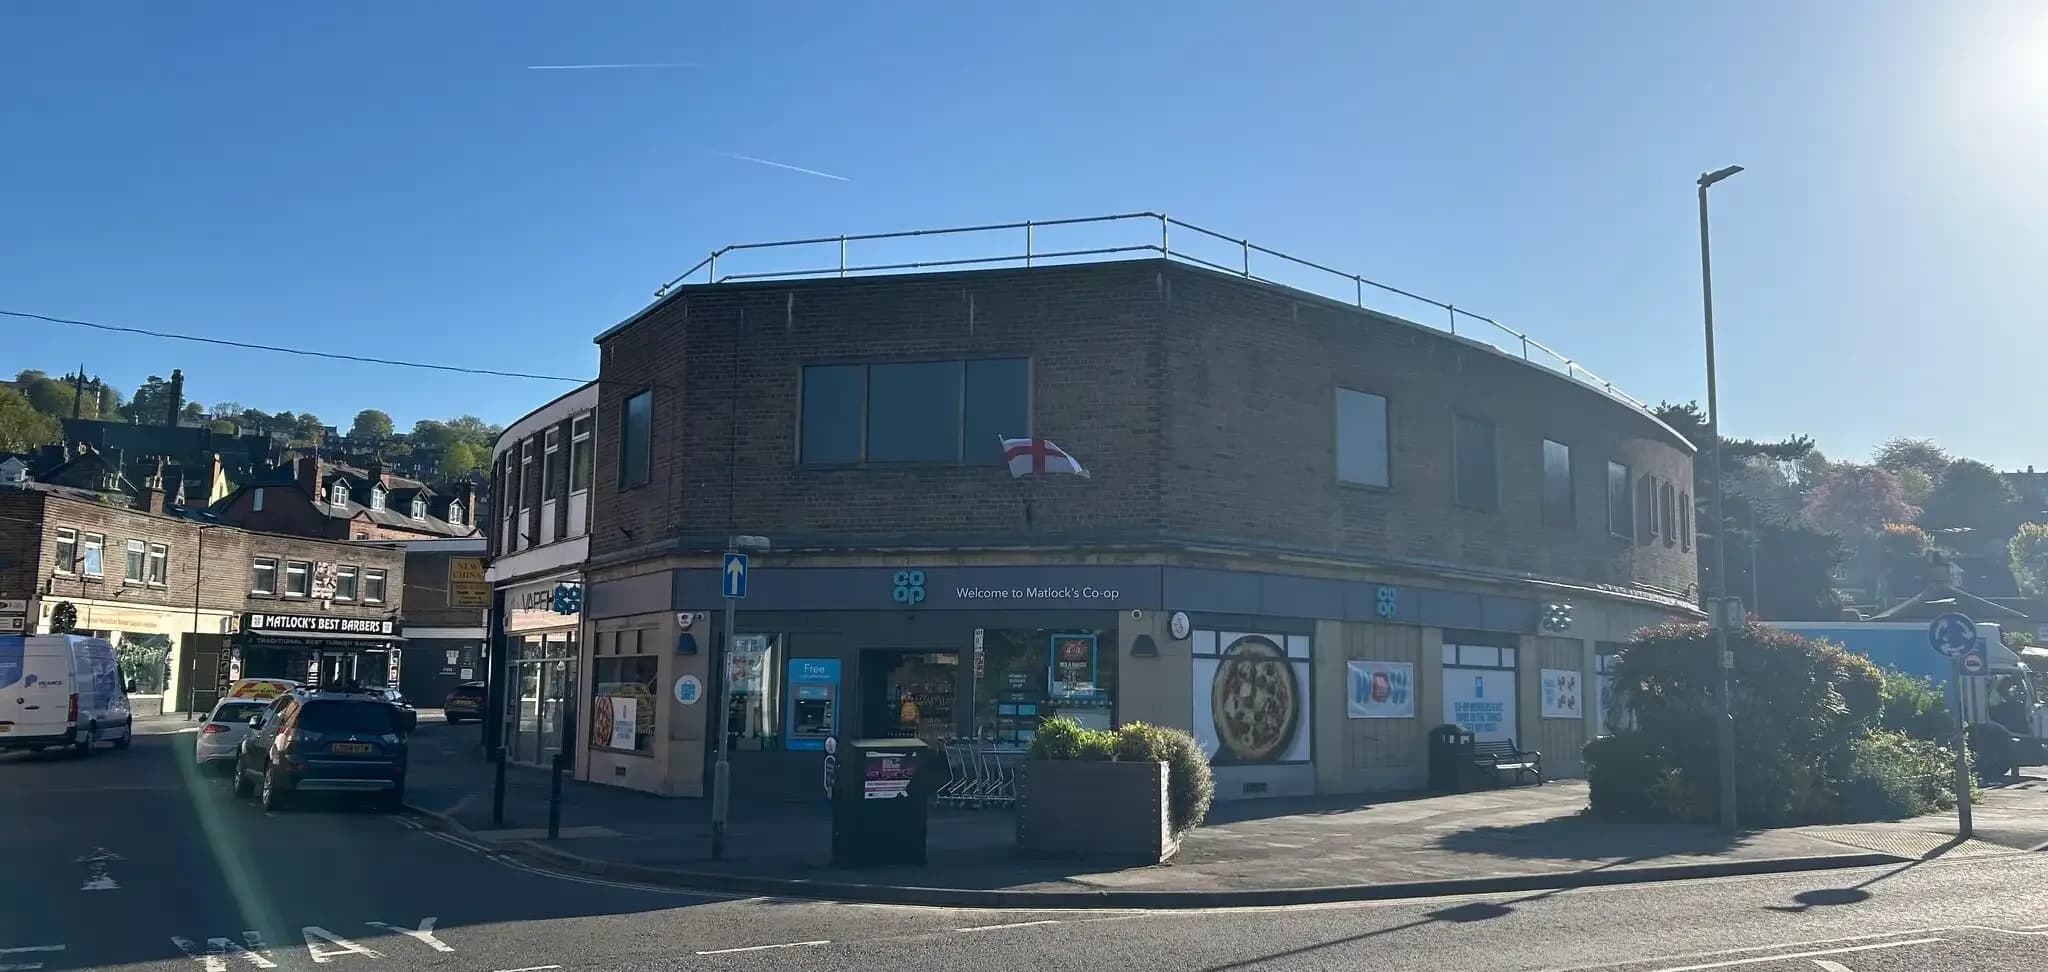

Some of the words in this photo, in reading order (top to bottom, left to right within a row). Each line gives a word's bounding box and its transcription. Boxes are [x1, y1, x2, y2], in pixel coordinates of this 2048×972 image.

[956, 586, 1009, 599] Welcome
[1012, 588, 1023, 599] to
[1026, 586, 1080, 599] Matlock's
[1083, 586, 1119, 601] Co-op
[265, 615, 317, 629] MATLOCK'S
[318, 618, 340, 630] BEST
[341, 620, 380, 632] BARBERS
[804, 663, 825, 674] Free
[170, 916, 456, 972] WAY
